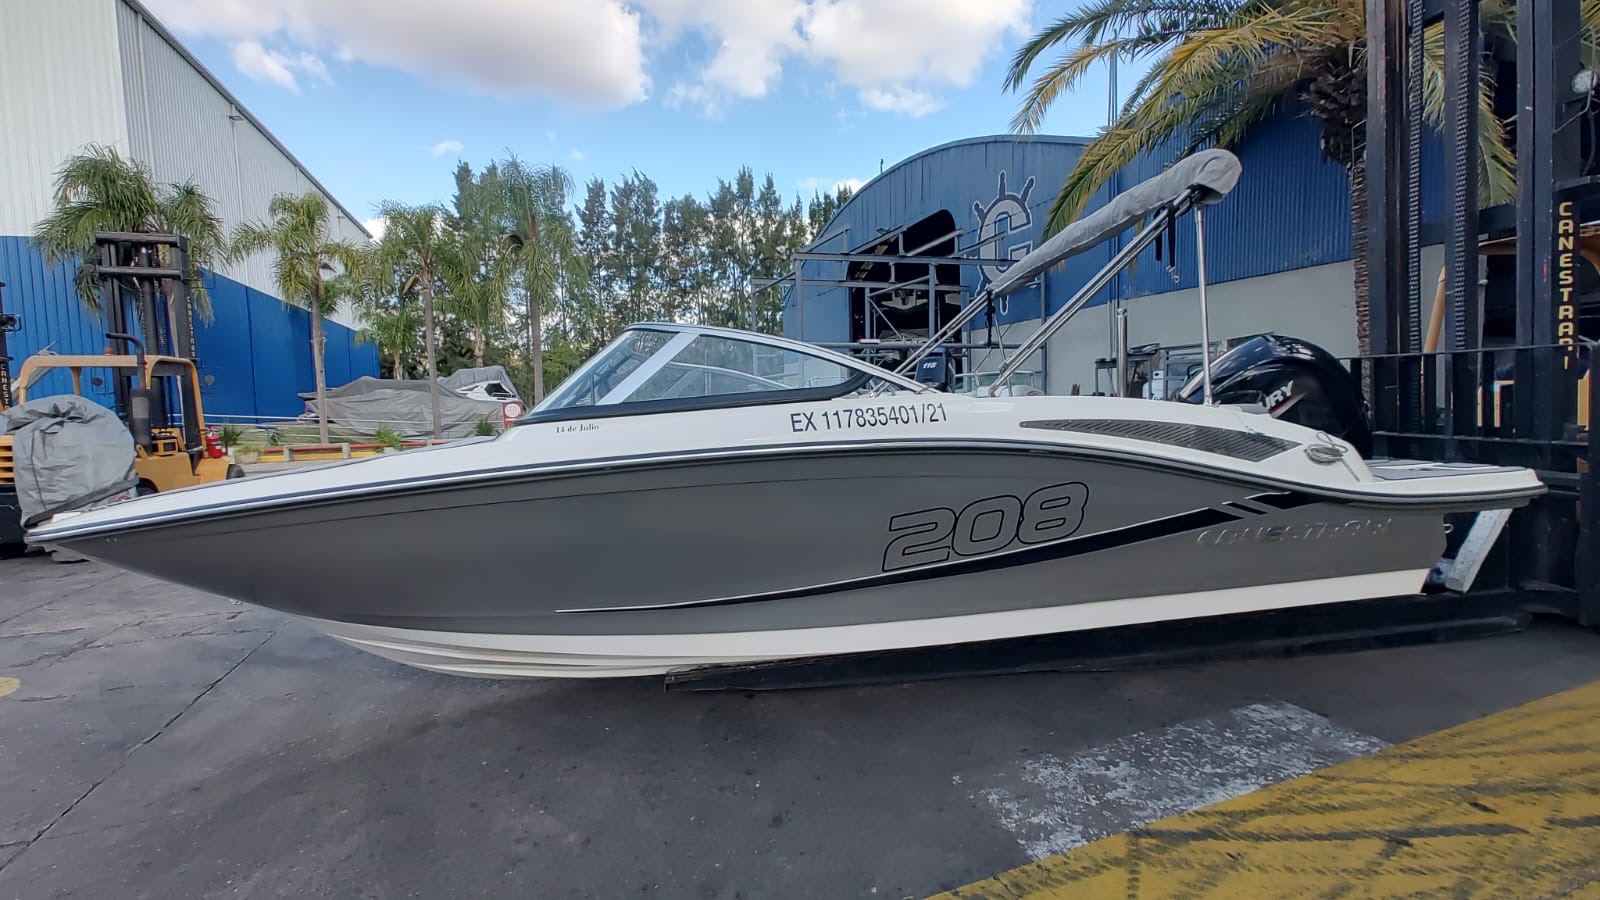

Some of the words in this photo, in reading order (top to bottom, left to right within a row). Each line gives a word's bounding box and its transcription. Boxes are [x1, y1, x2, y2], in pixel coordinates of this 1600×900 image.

[1558, 201, 1574, 370] CANESTRARI
[790, 411, 817, 432] EX
[821, 402, 947, 430] 117835401/21
[882, 481, 1089, 573] 208
